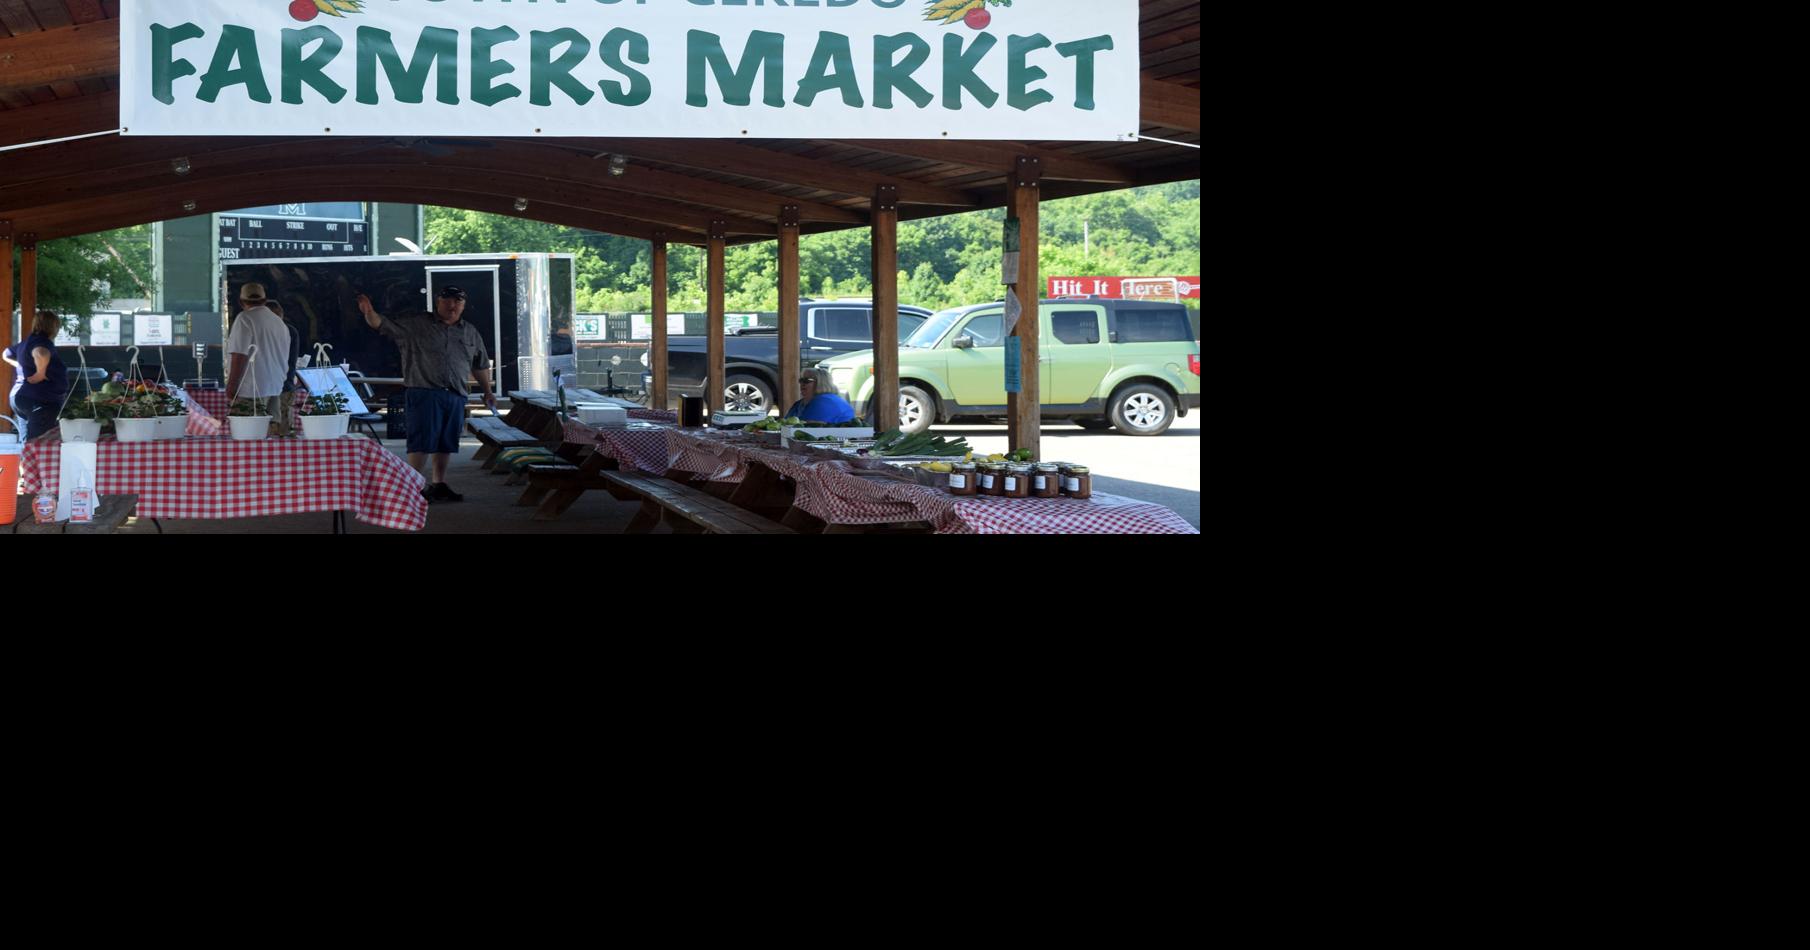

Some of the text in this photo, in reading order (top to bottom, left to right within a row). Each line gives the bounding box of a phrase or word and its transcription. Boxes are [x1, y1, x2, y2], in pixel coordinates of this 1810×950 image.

[149, 22, 1114, 111] FARMERS MARKET
[248, 219, 264, 228] BALL
[286, 221, 304, 230] STRIKE
[326, 223, 338, 231] OUT
[1052, 279, 1083, 296] Hit
[1092, 279, 1109, 296] It
